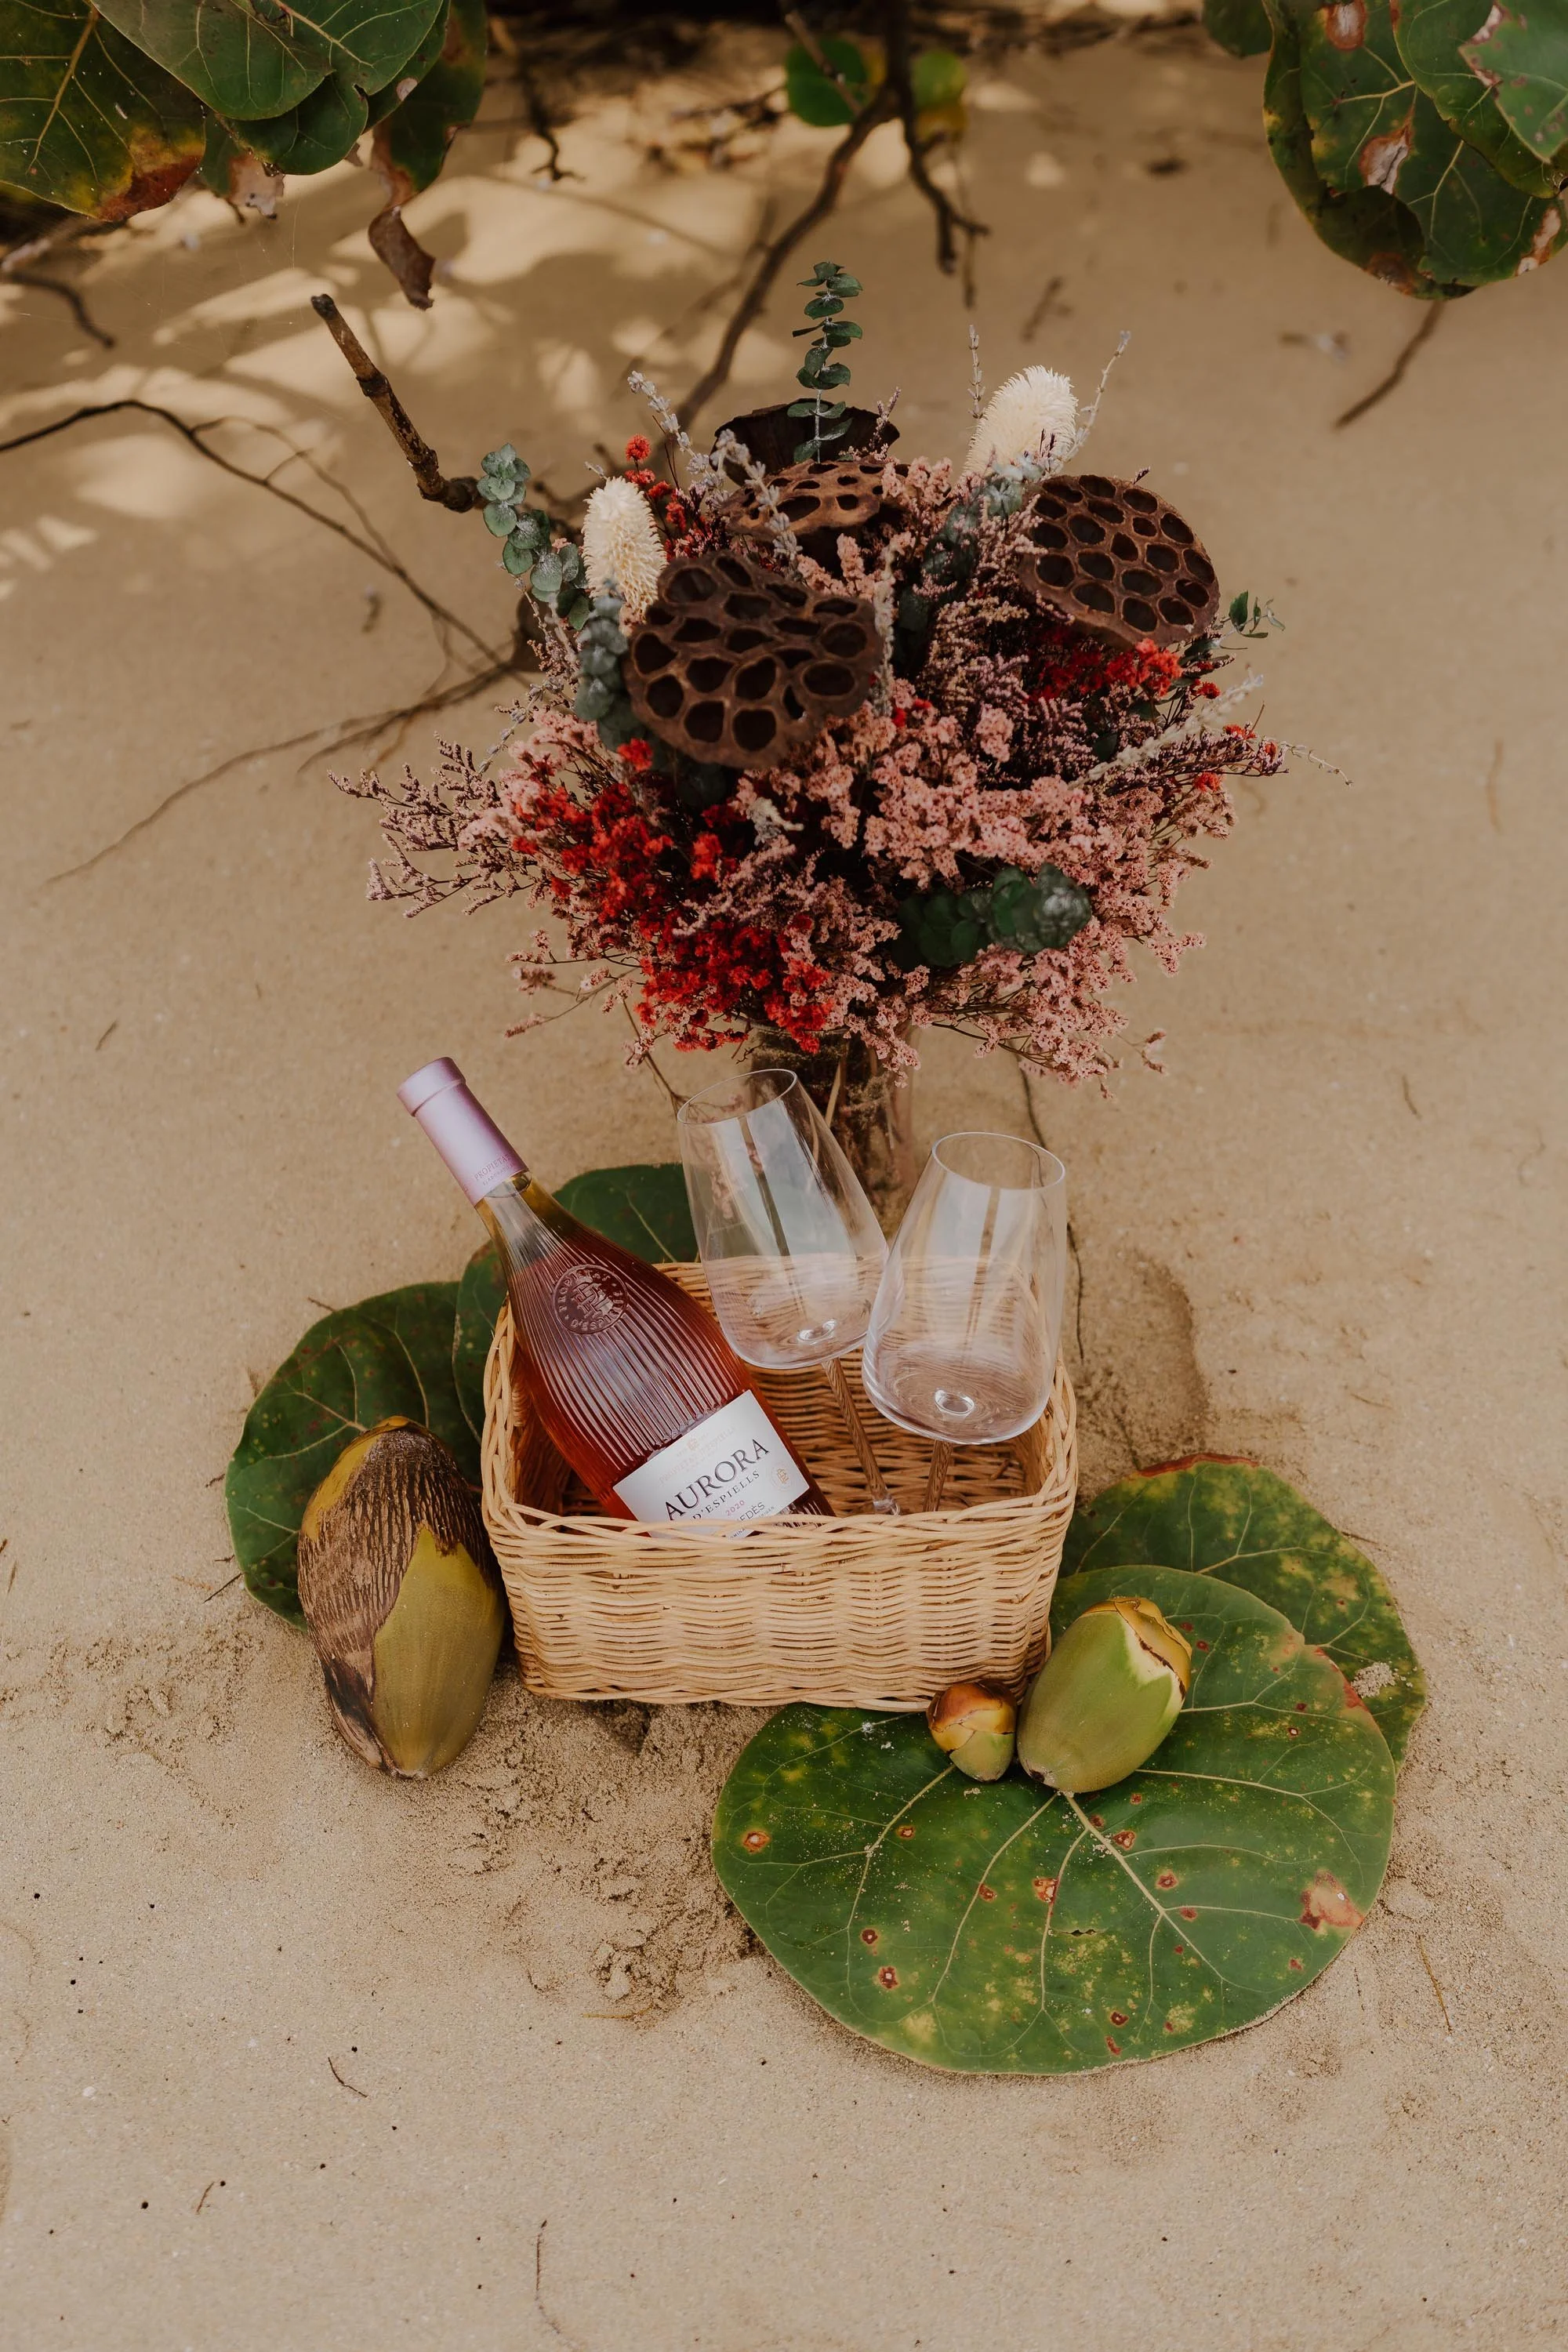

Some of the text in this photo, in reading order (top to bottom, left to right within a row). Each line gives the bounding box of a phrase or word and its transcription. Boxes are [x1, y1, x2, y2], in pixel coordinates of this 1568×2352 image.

[665, 1438, 770, 1520] AURORA
[725, 1500, 746, 1516] 2020
[738, 1501, 765, 1521] EDÈS
